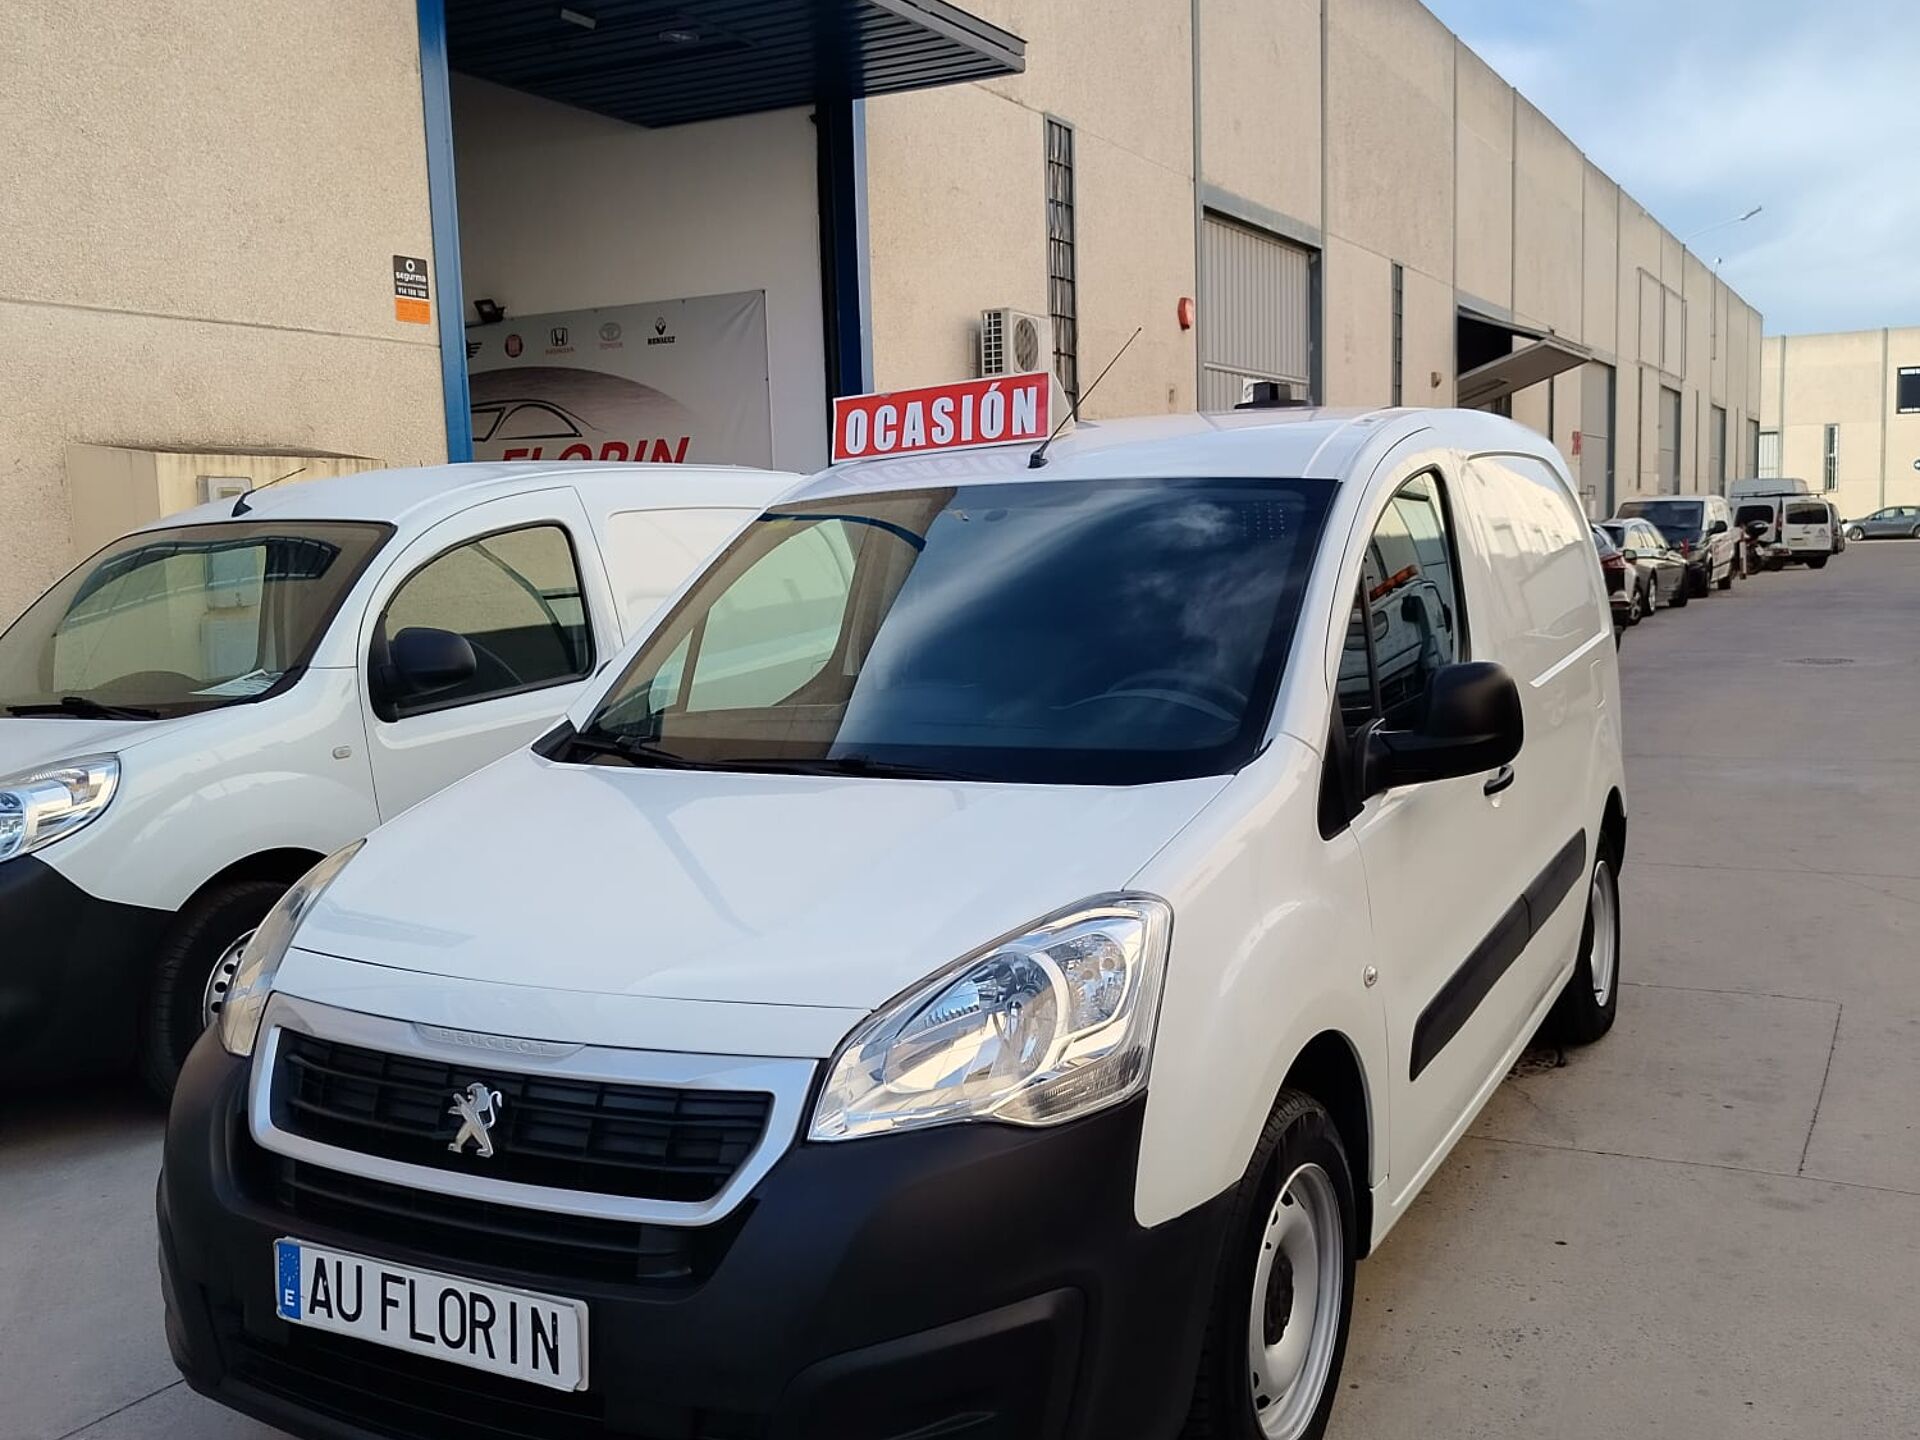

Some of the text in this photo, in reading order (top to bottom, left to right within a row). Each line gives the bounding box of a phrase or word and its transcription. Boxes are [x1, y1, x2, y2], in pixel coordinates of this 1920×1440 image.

[845, 382, 1038, 455] OCASIÓN
[439, 1031, 548, 1053] PEUGEOT
[284, 1289, 295, 1306] E
[308, 1257, 559, 1375] AU FLORIN
